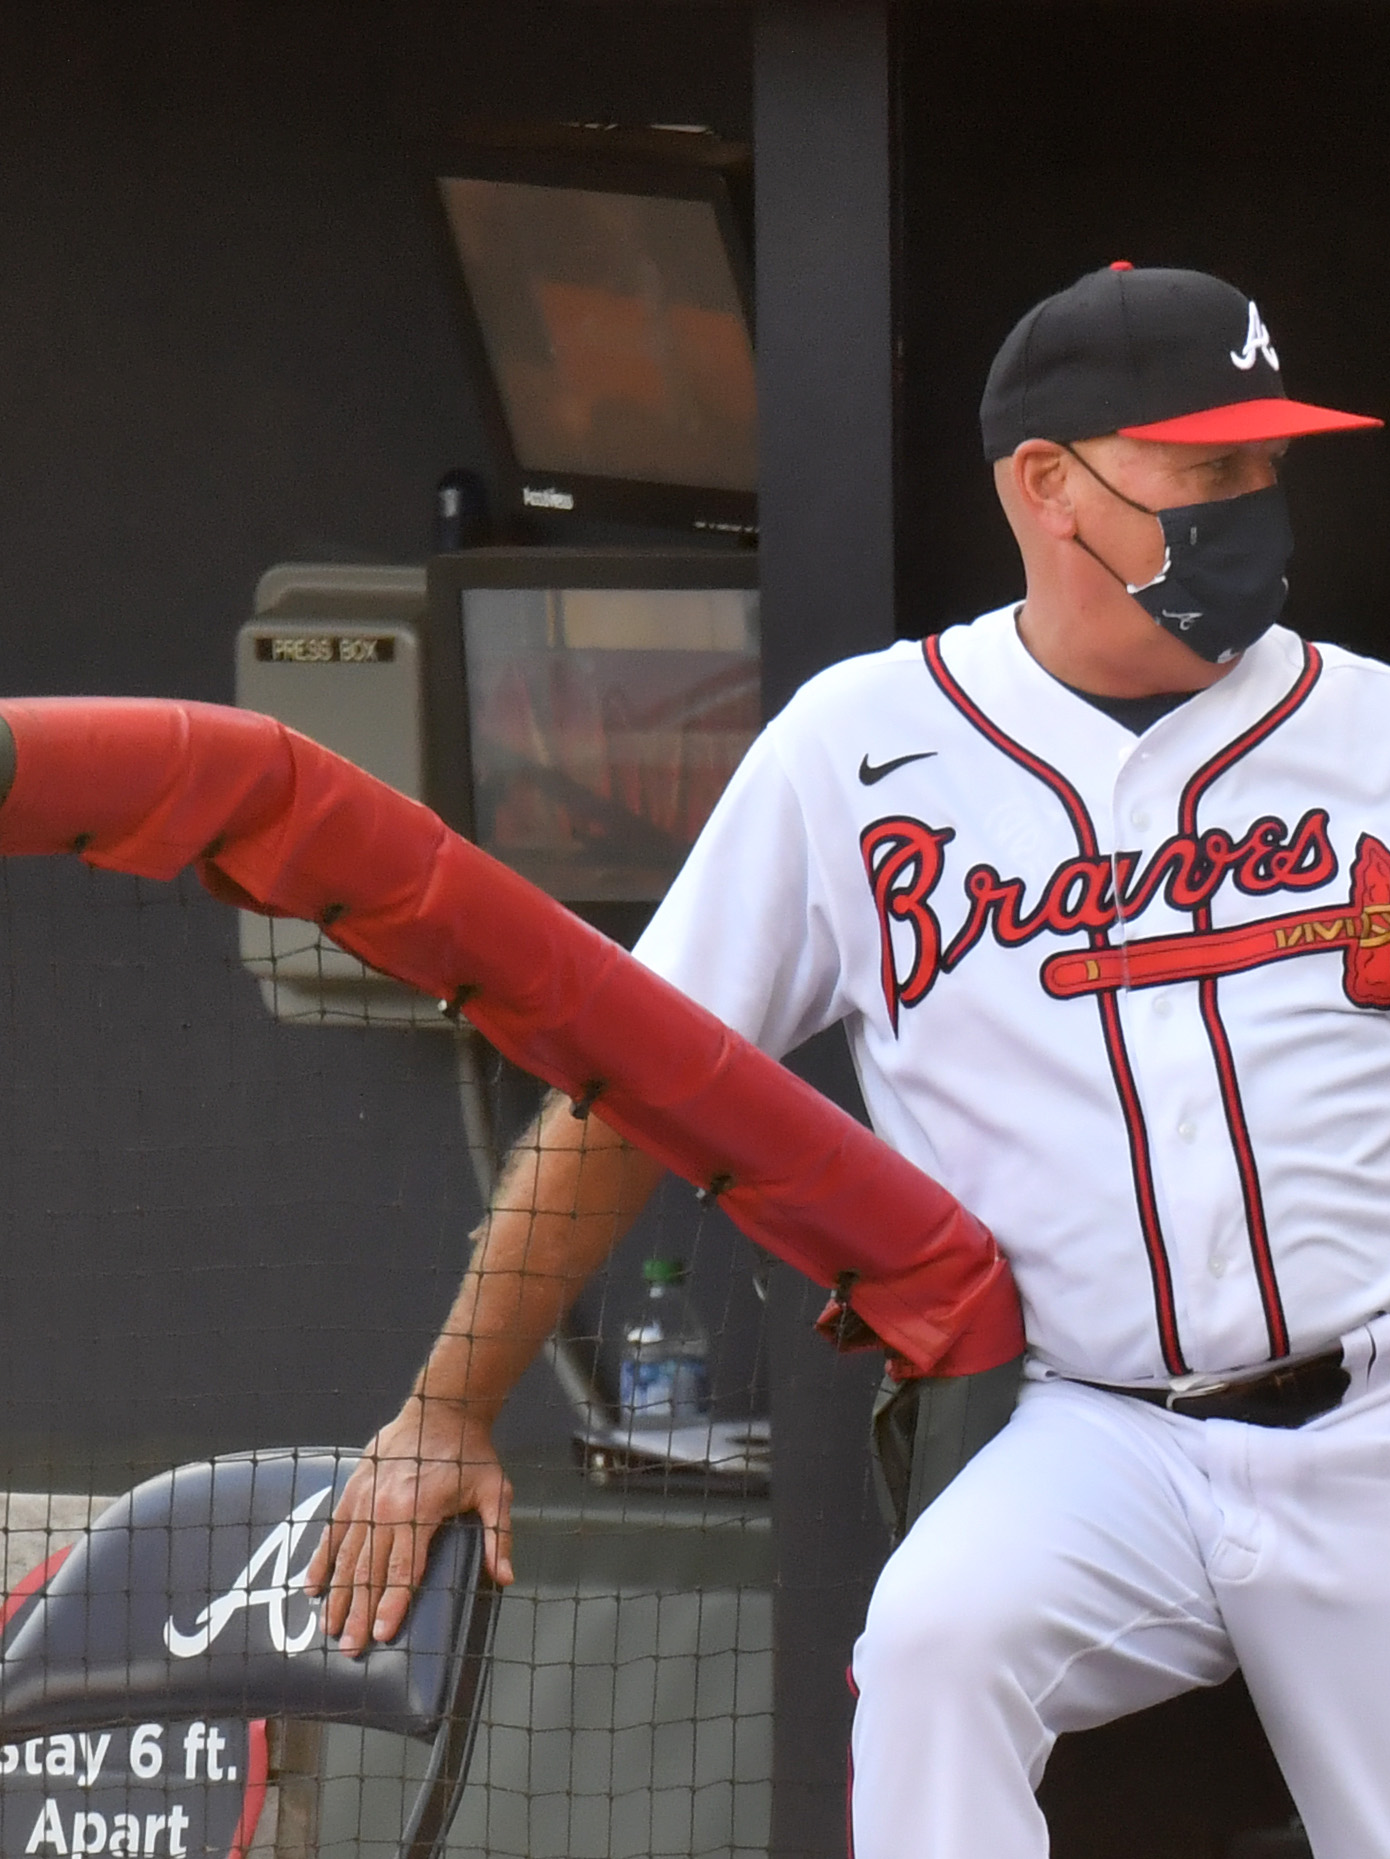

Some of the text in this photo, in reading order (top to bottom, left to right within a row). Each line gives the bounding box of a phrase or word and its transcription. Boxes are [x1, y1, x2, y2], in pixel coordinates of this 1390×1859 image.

[1230, 300, 1279, 371] A
[272, 638, 379, 662] PRESS BOX
[860, 809, 1337, 1040] Braves
[130, 1723, 164, 1779] 6
[183, 1721, 237, 1781] ft.
[25, 1798, 190, 1859] Apart
